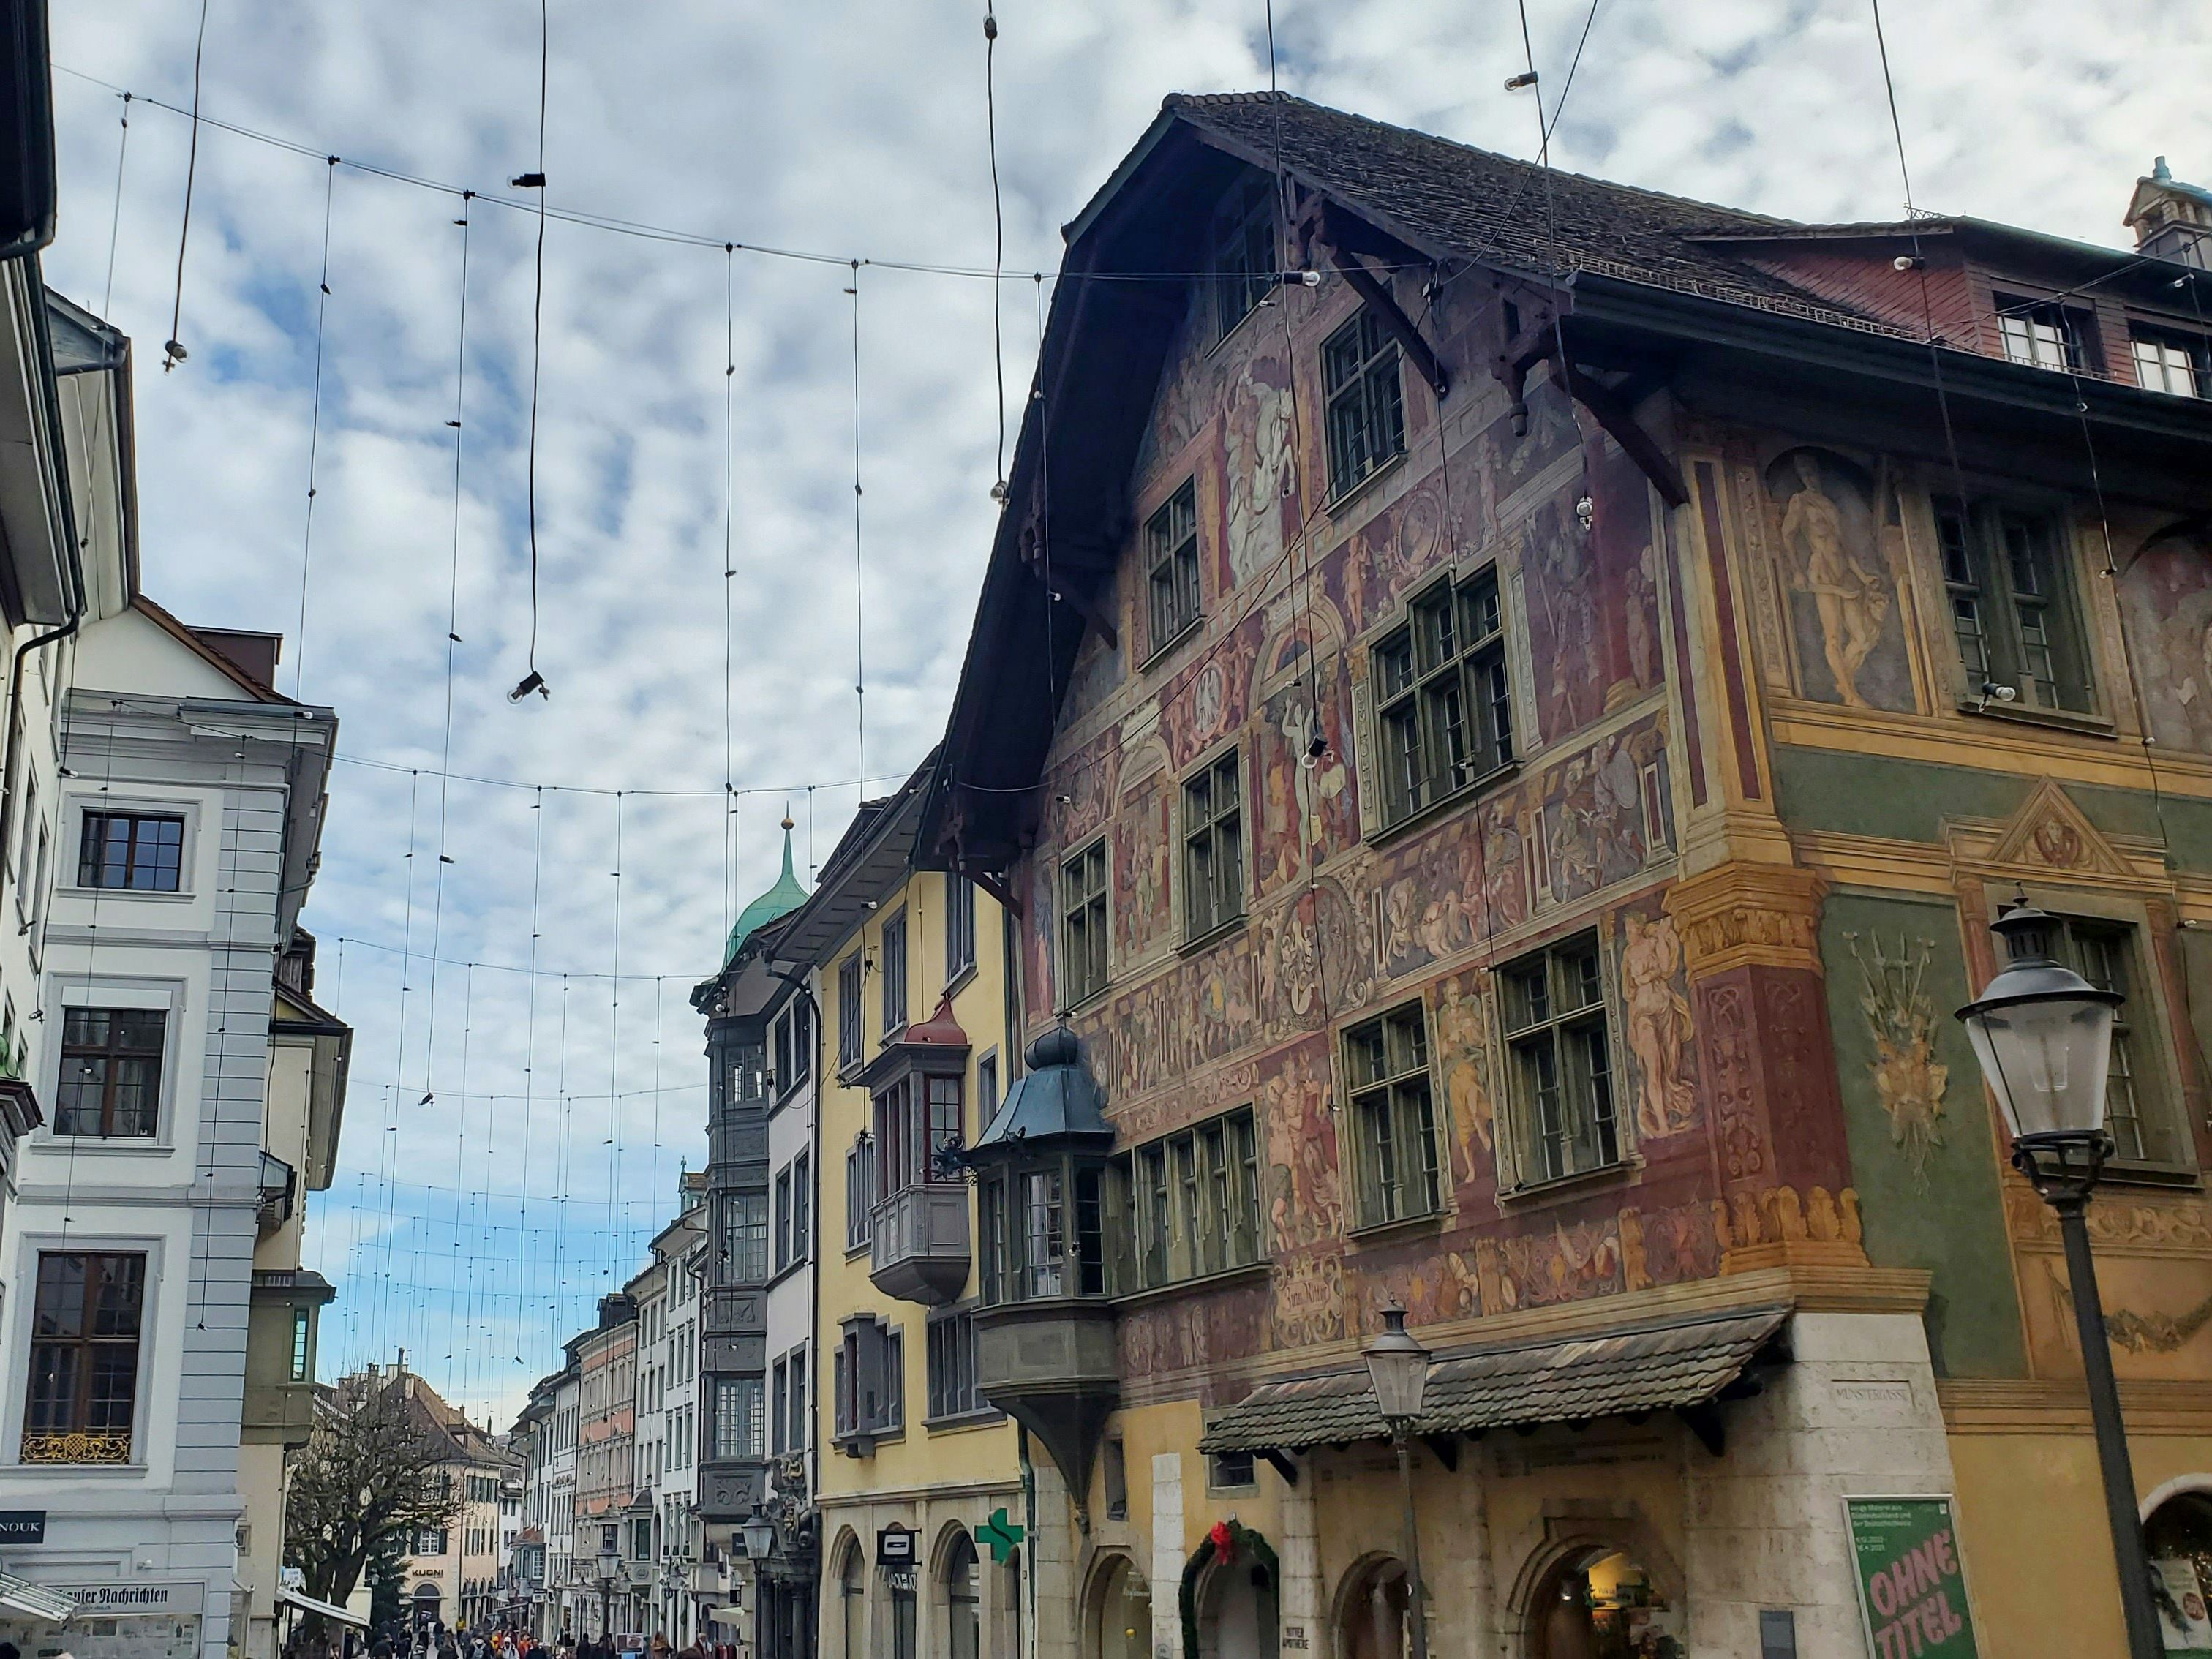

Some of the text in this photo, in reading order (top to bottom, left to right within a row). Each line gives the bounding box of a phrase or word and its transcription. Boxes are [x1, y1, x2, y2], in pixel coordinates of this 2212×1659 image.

[99, 1587, 168, 1605] Nachrichten
[1870, 1529, 1958, 1617] OHNE
[1875, 1591, 1962, 1659] TITEL
